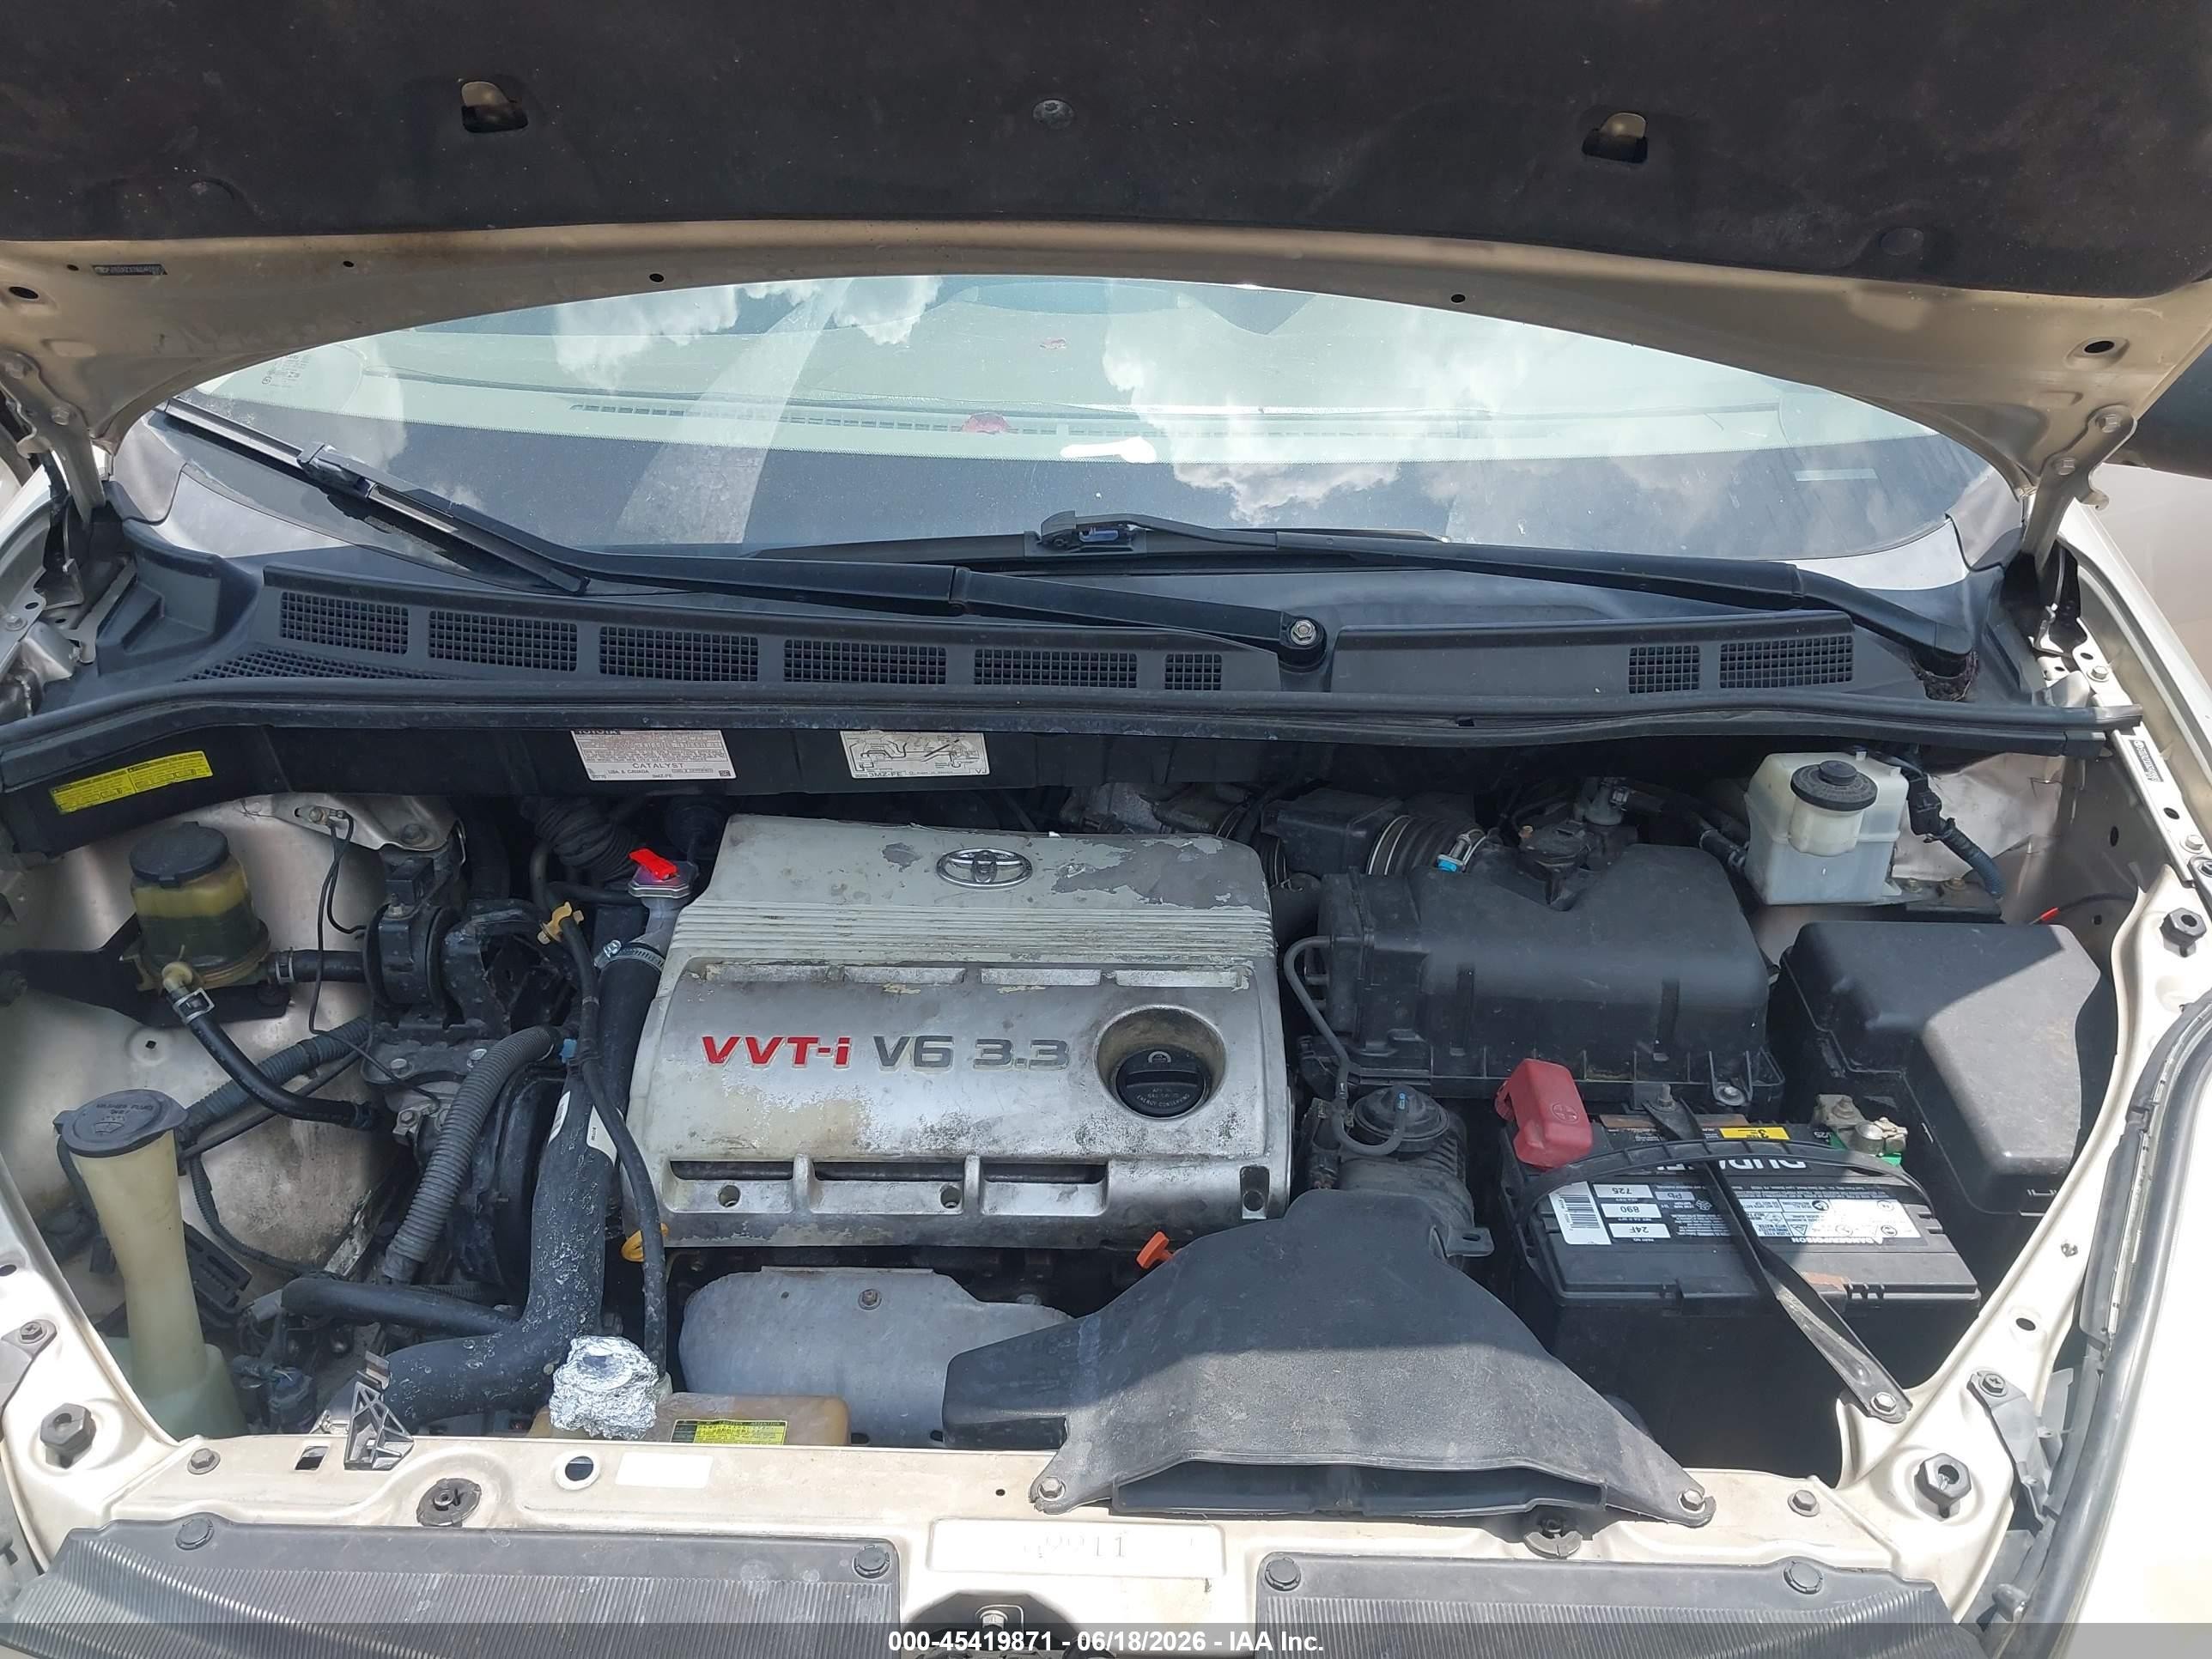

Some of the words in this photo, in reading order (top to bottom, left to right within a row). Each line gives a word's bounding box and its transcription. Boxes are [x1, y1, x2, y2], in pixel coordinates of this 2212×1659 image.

[702, 1035, 853, 1069] VVT-i
[872, 1035, 954, 1071] V6
[972, 1038, 1070, 1071] 3.3
[1757, 1129, 1769, 1139] 3
